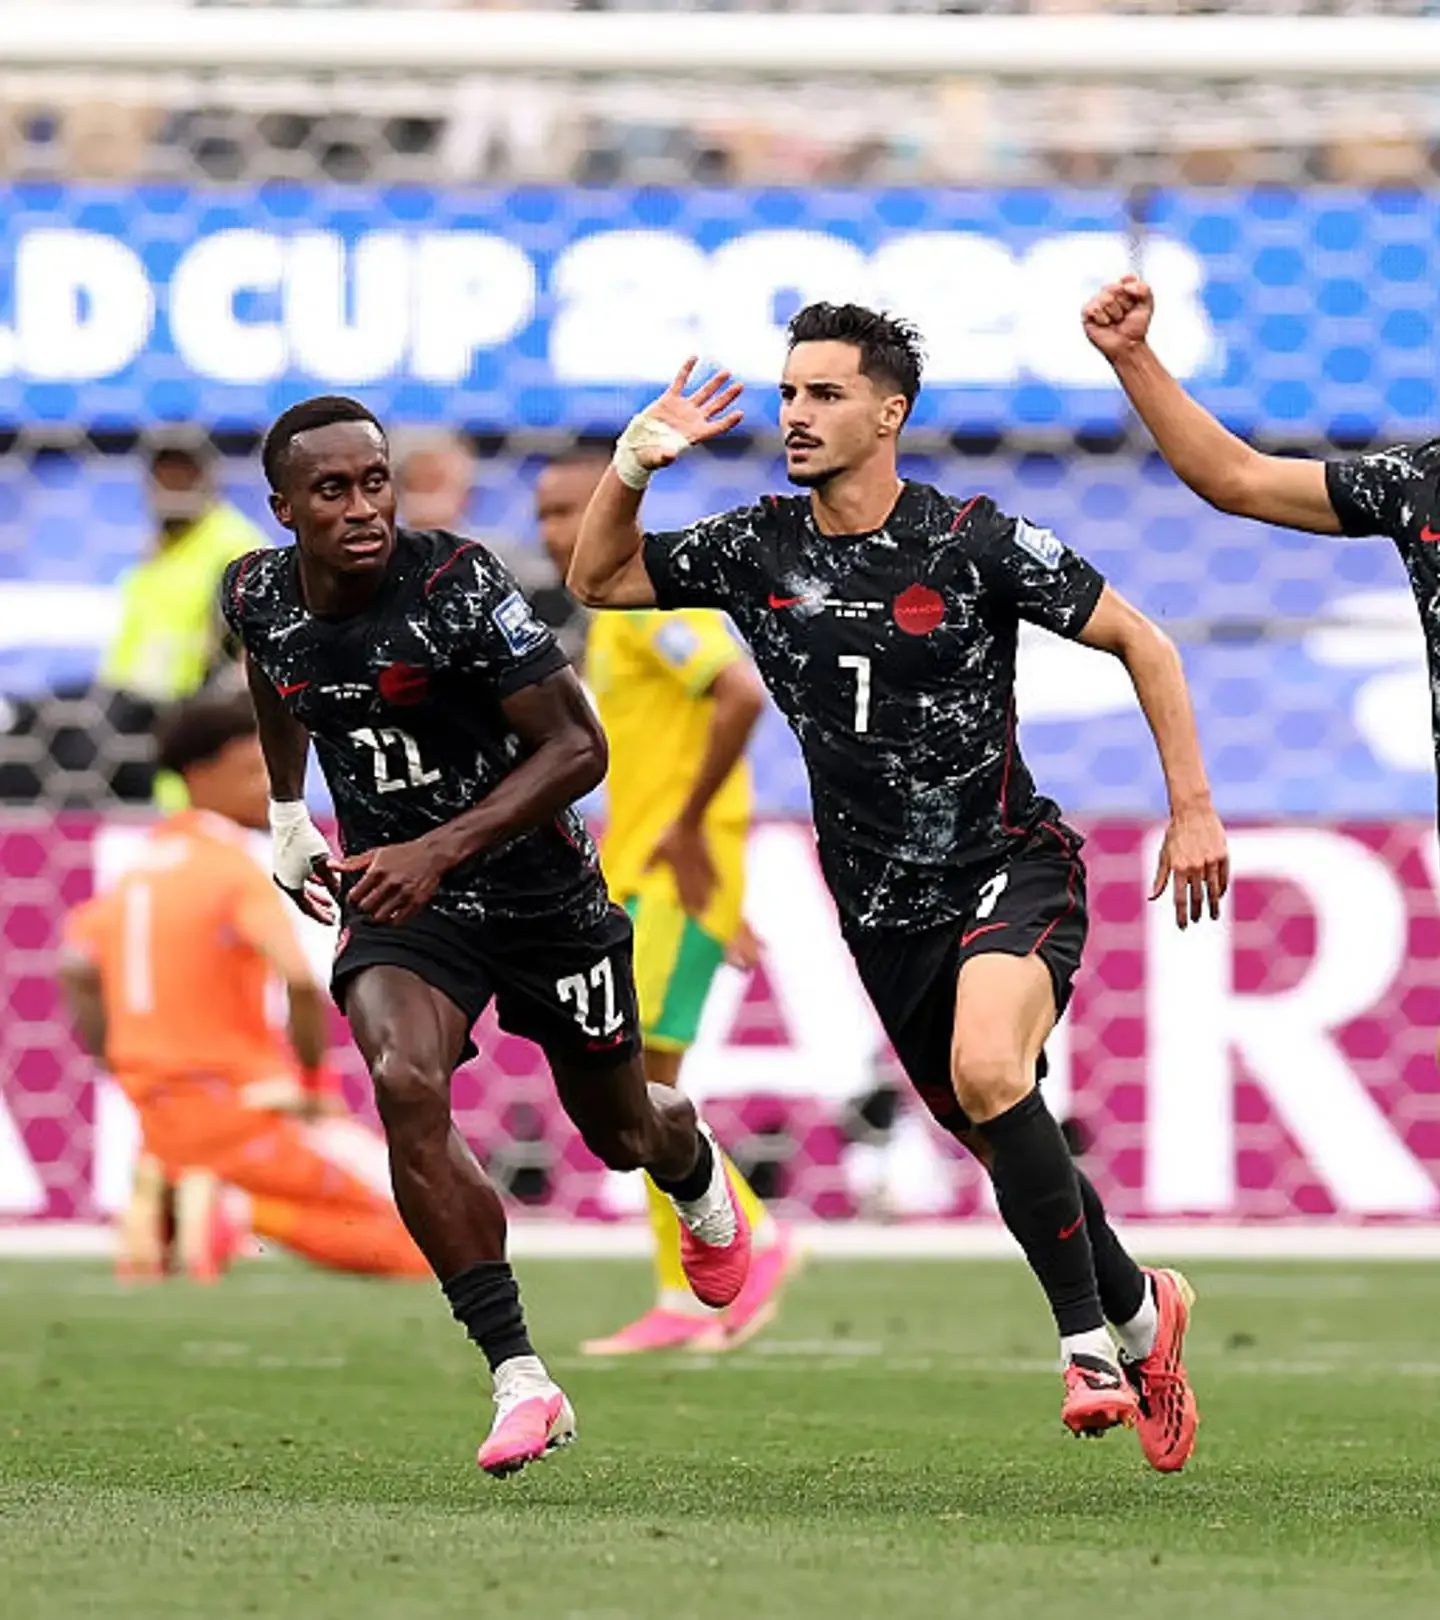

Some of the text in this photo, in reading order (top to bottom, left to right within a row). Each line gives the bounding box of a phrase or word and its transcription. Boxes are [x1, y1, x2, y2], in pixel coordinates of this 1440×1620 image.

[0, 226, 153, 382] D
[170, 226, 535, 386] CUP
[838, 655, 871, 733] 7
[347, 727, 442, 794] 22
[122, 882, 153, 1014] 1
[556, 956, 625, 1036] 22
